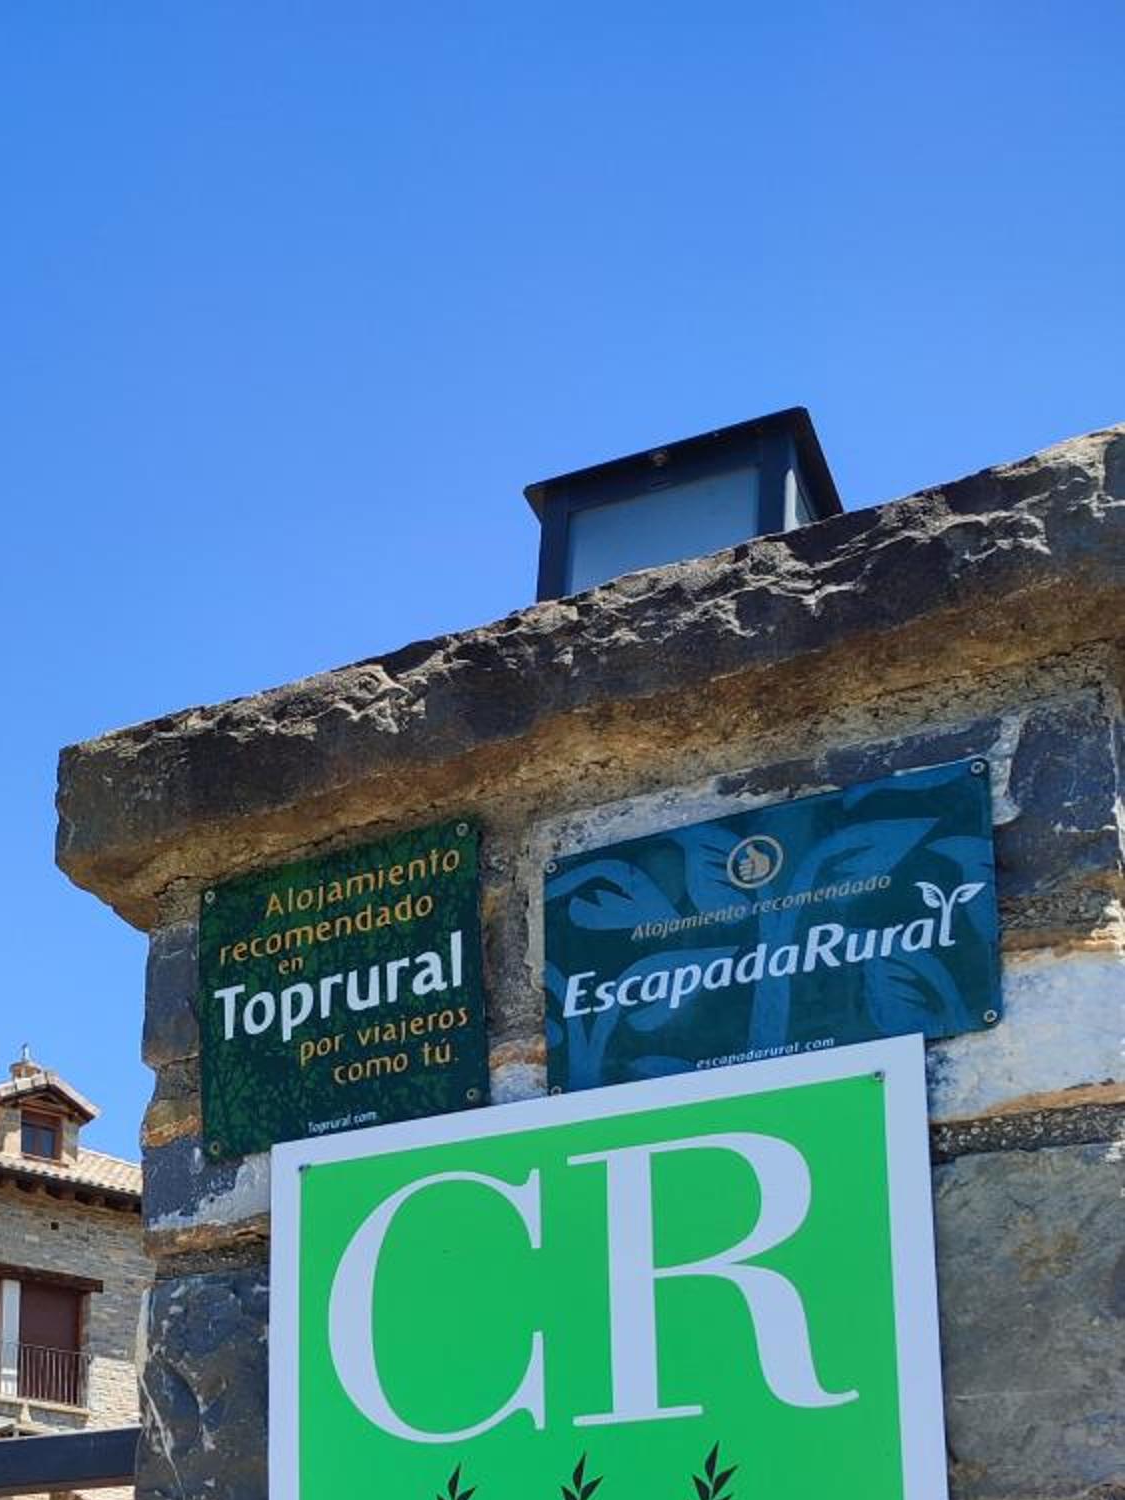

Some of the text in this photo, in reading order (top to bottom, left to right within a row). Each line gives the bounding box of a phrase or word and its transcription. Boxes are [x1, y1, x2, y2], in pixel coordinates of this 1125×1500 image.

[265, 848, 460, 918] Alojamiento
[631, 875, 891, 941] Alojamiento recomendado
[219, 894, 433, 966] recomendado
[278, 955, 304, 975] en
[563, 882, 984, 1019] EscapadaRural
[214, 930, 463, 1042] Toprural
[300, 1007, 468, 1066] por viajeros
[334, 1053, 408, 1085] como
[328, 1132, 860, 1444] CR
